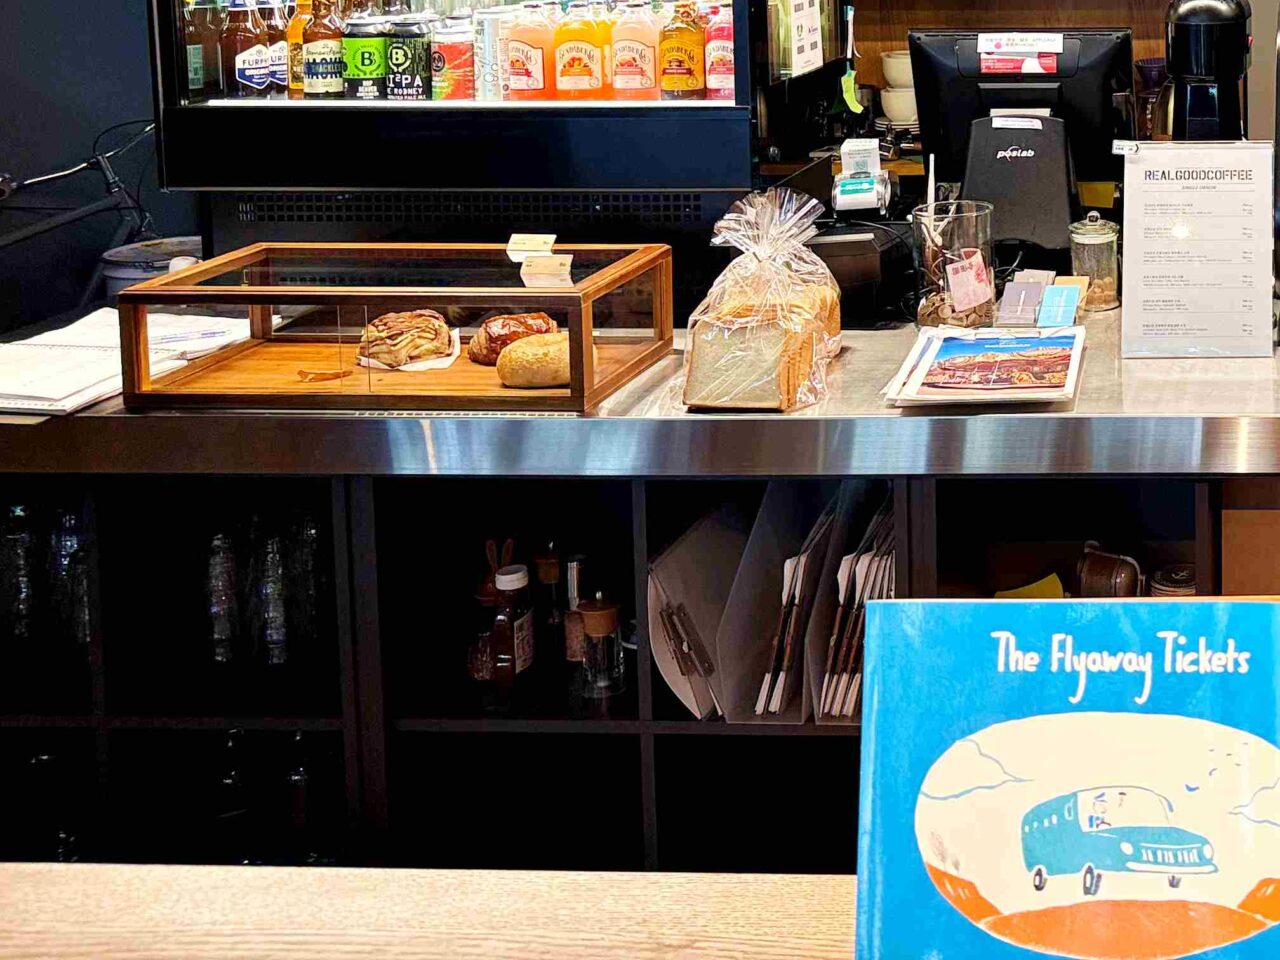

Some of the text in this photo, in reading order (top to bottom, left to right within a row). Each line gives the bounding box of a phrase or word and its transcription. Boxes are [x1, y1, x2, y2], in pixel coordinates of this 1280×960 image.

[1144, 169, 1254, 181] REALGOODCOFFEE
[990, 630, 1251, 705] The Flyaway Tickets
